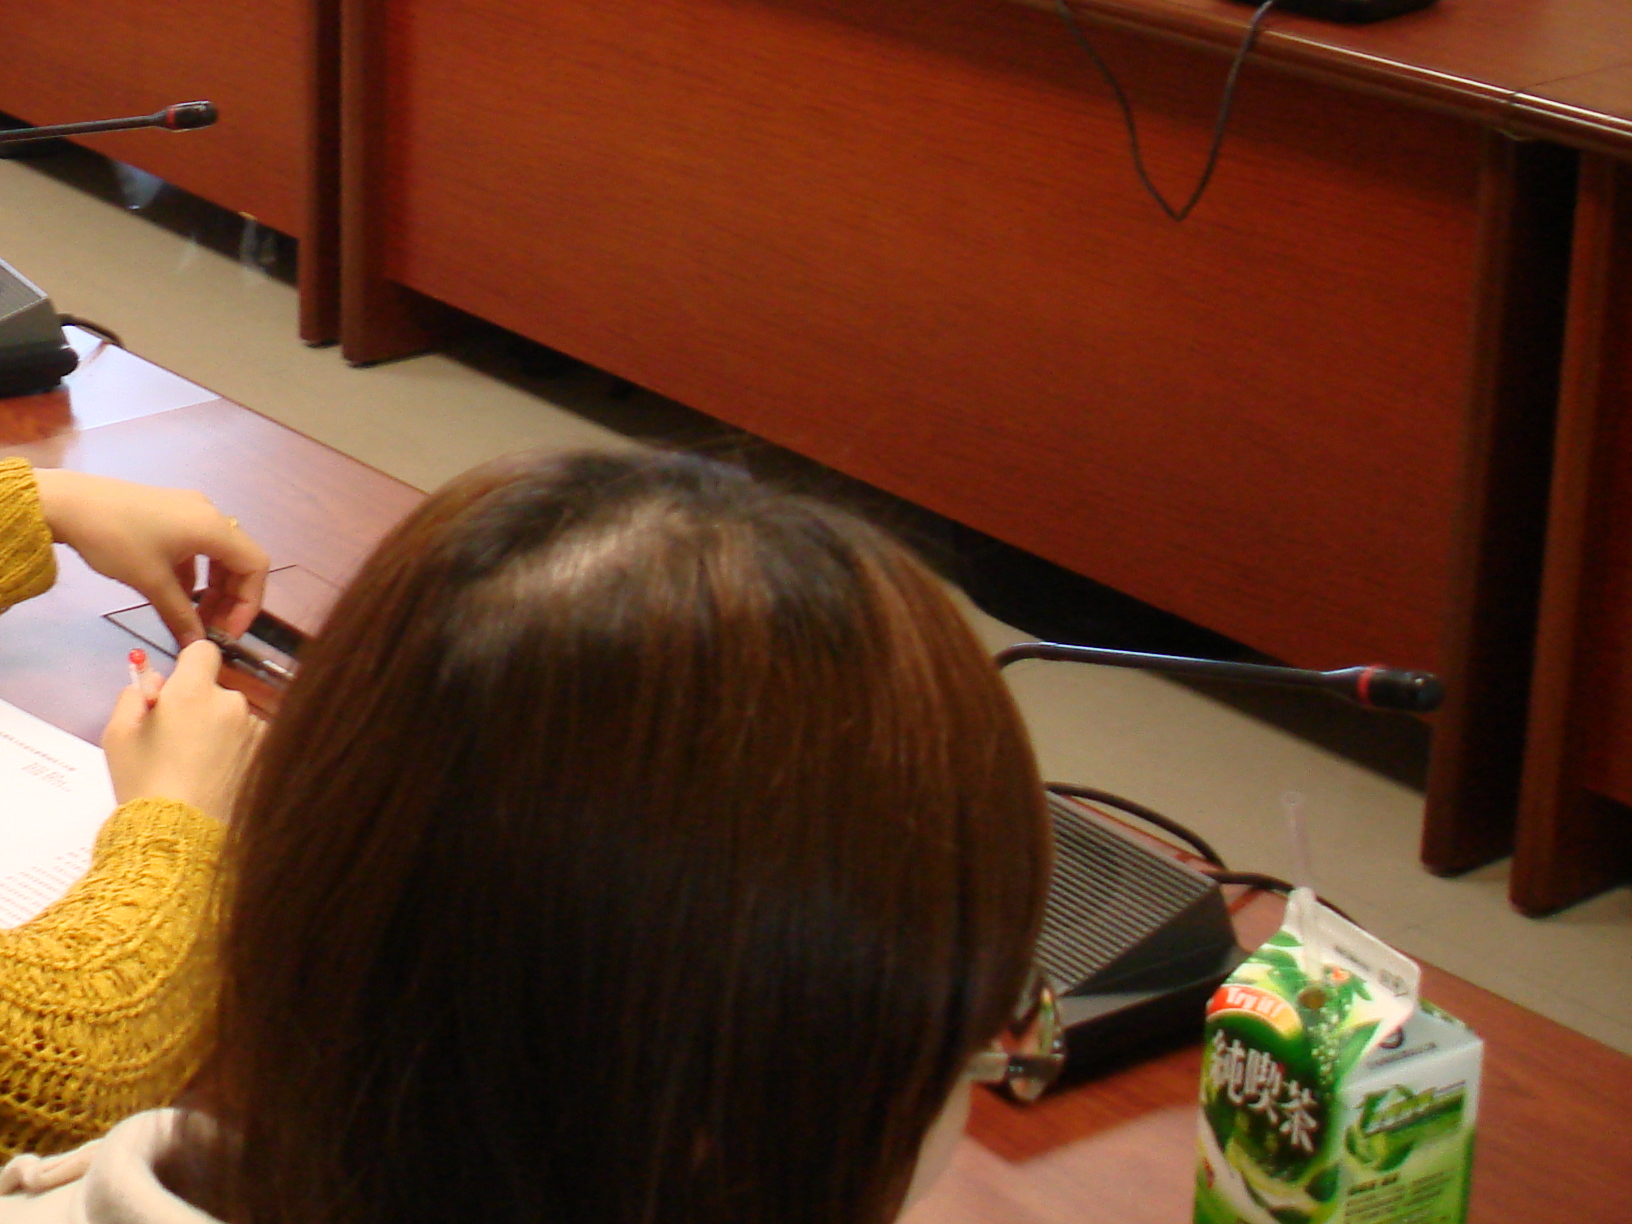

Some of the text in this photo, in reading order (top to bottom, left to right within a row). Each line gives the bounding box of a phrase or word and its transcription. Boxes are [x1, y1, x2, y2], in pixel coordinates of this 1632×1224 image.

[1225, 987, 1258, 1009] Try
[1210, 1029, 1317, 1152] 純喫茶
